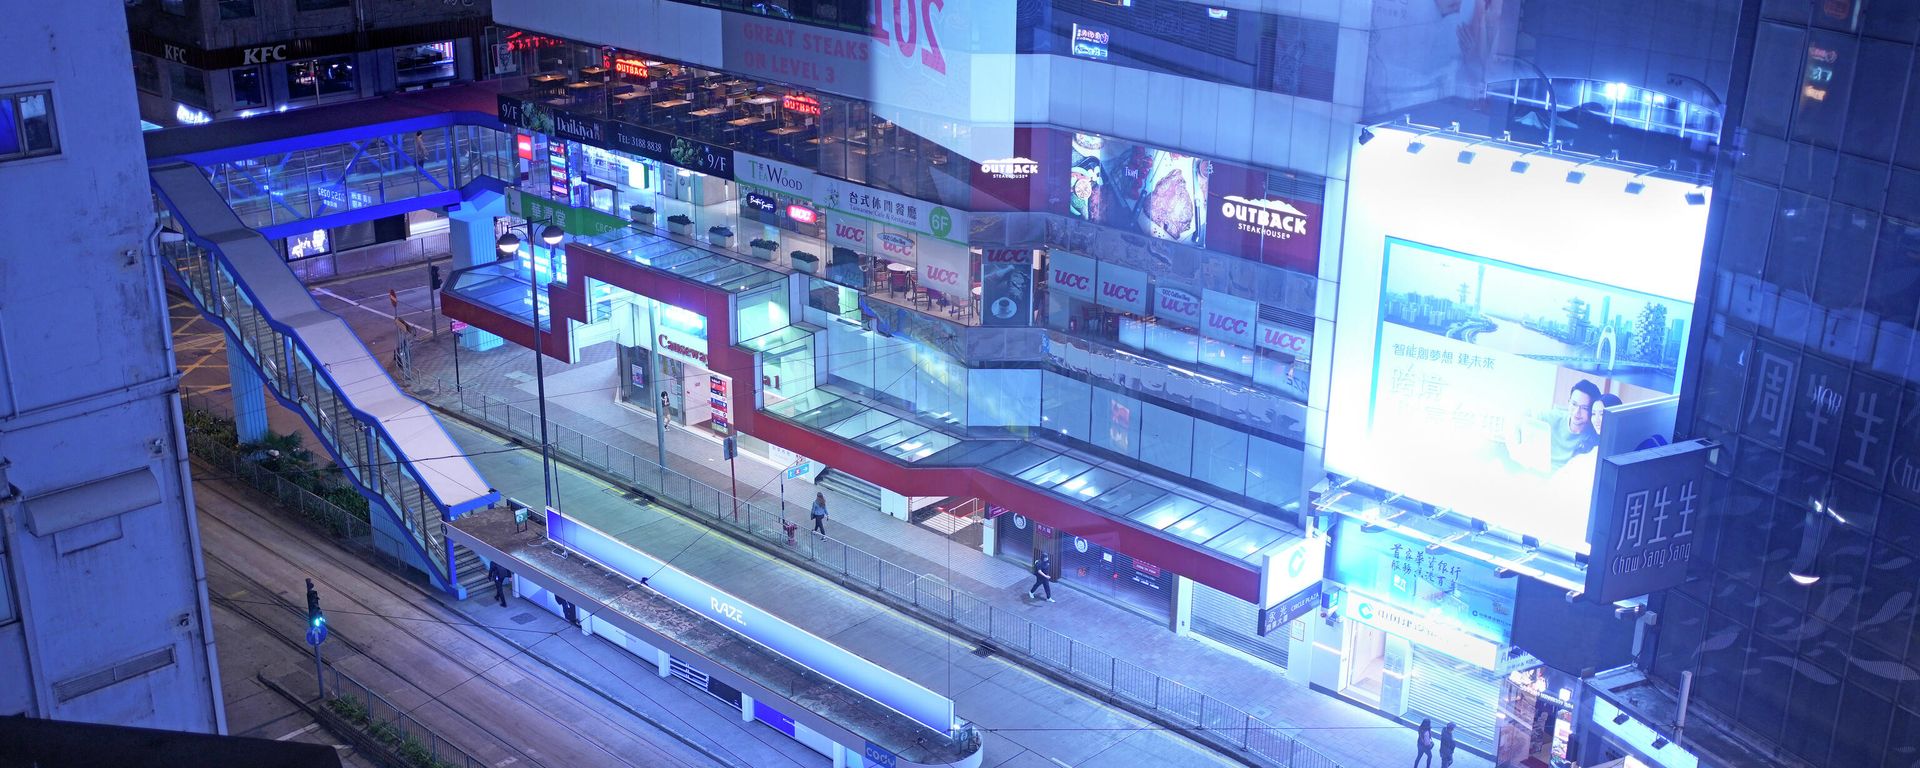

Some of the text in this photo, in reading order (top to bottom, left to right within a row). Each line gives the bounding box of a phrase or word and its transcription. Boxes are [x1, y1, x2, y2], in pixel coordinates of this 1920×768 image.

[743, 22, 870, 62] GREAT STEAKS
[164, 44, 187, 64] KFC
[243, 44, 287, 65] KFC
[616, 62, 649, 78] OUTBACK
[744, 51, 835, 84] ON LEVEL 3
[501, 104, 518, 120] 9/F
[783, 99, 821, 115] OUTBACK
[557, 116, 595, 141] Daikiya
[707, 153, 727, 172] 9/F
[981, 164, 1039, 174] OUTBACK
[931, 214, 950, 232] 6F
[1222, 202, 1307, 235] OUTBACK
[1747, 352, 1886, 476] 周生生
[1616, 480, 1698, 551] 周生生
[1612, 543, 1692, 575] Chow Sang Sang
[711, 596, 747, 626] RAZE.
